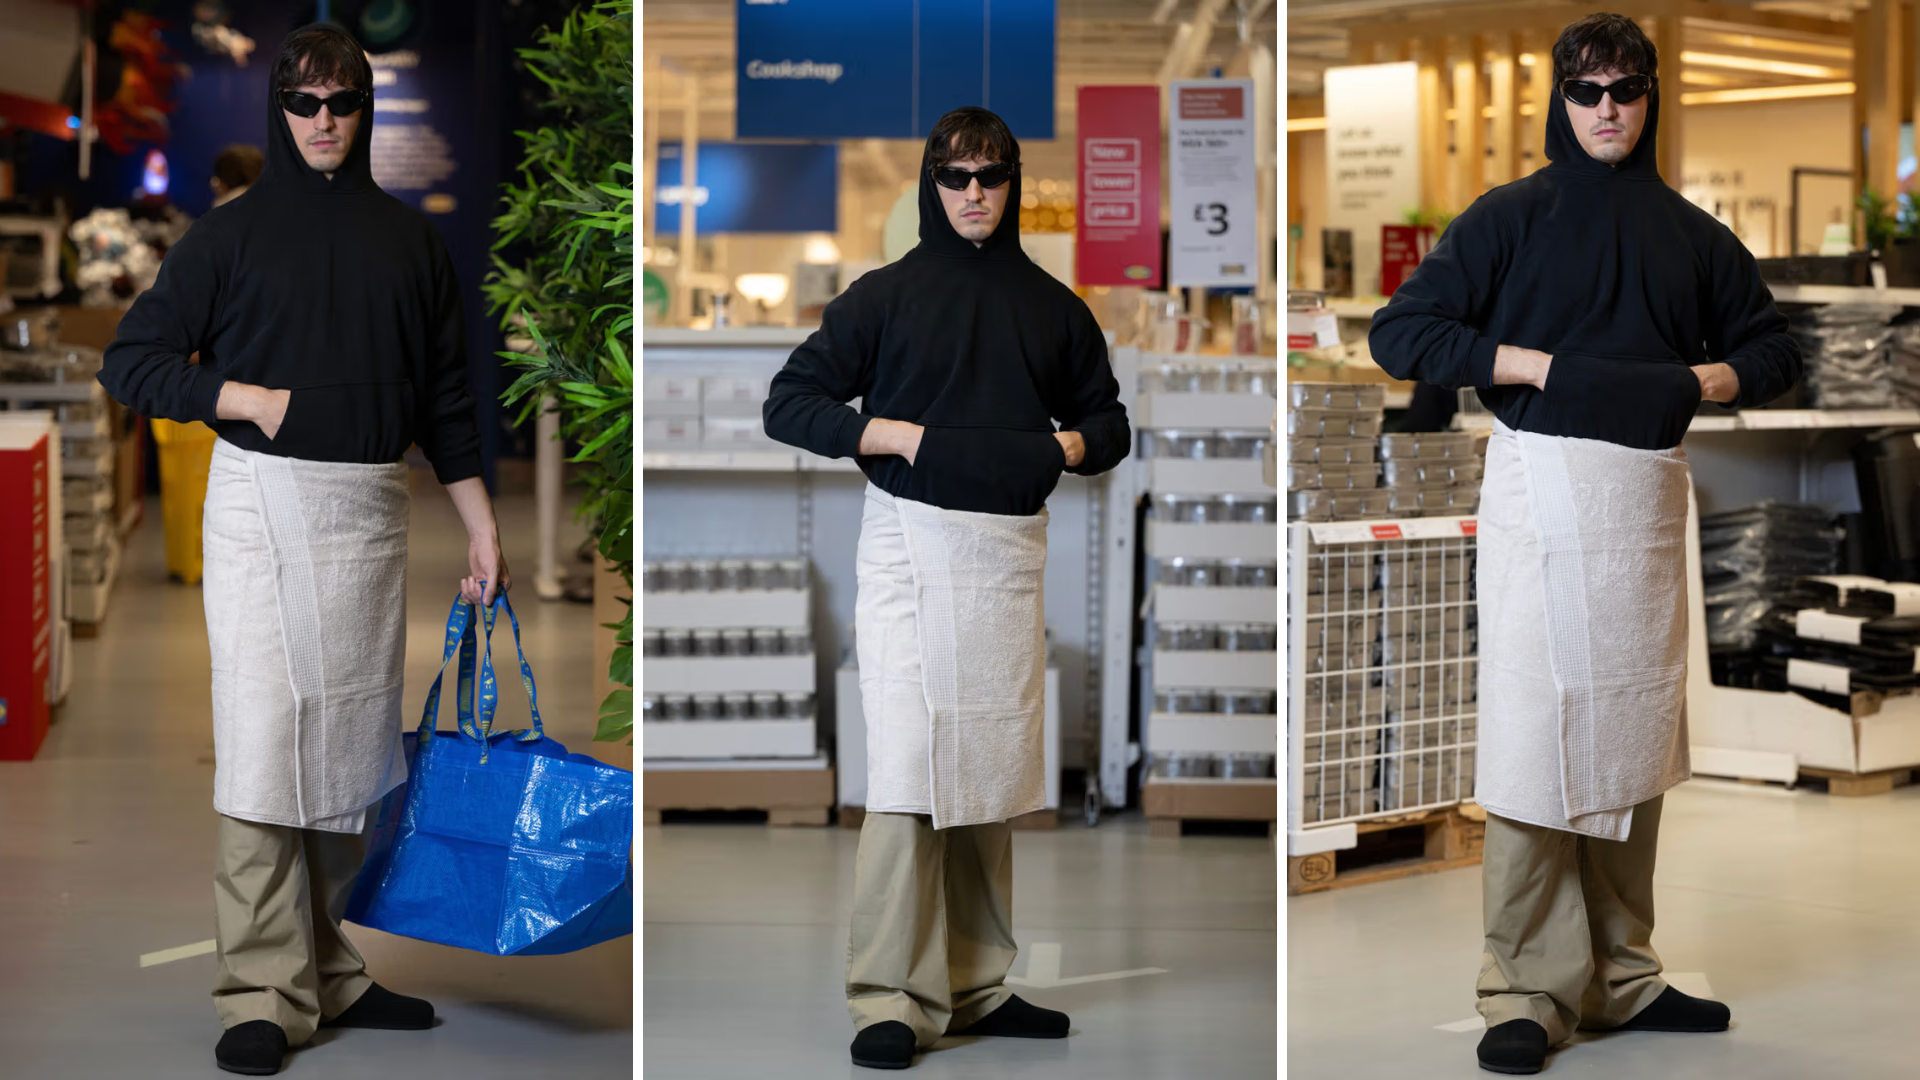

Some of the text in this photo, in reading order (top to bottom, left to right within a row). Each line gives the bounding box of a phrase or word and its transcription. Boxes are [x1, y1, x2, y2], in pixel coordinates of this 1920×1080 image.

[746, 59, 843, 84] Cookshop
[1092, 146, 1127, 159] New
[1092, 175, 1134, 189] lower
[1092, 203, 1130, 219] price
[1193, 203, 1229, 236] £3
